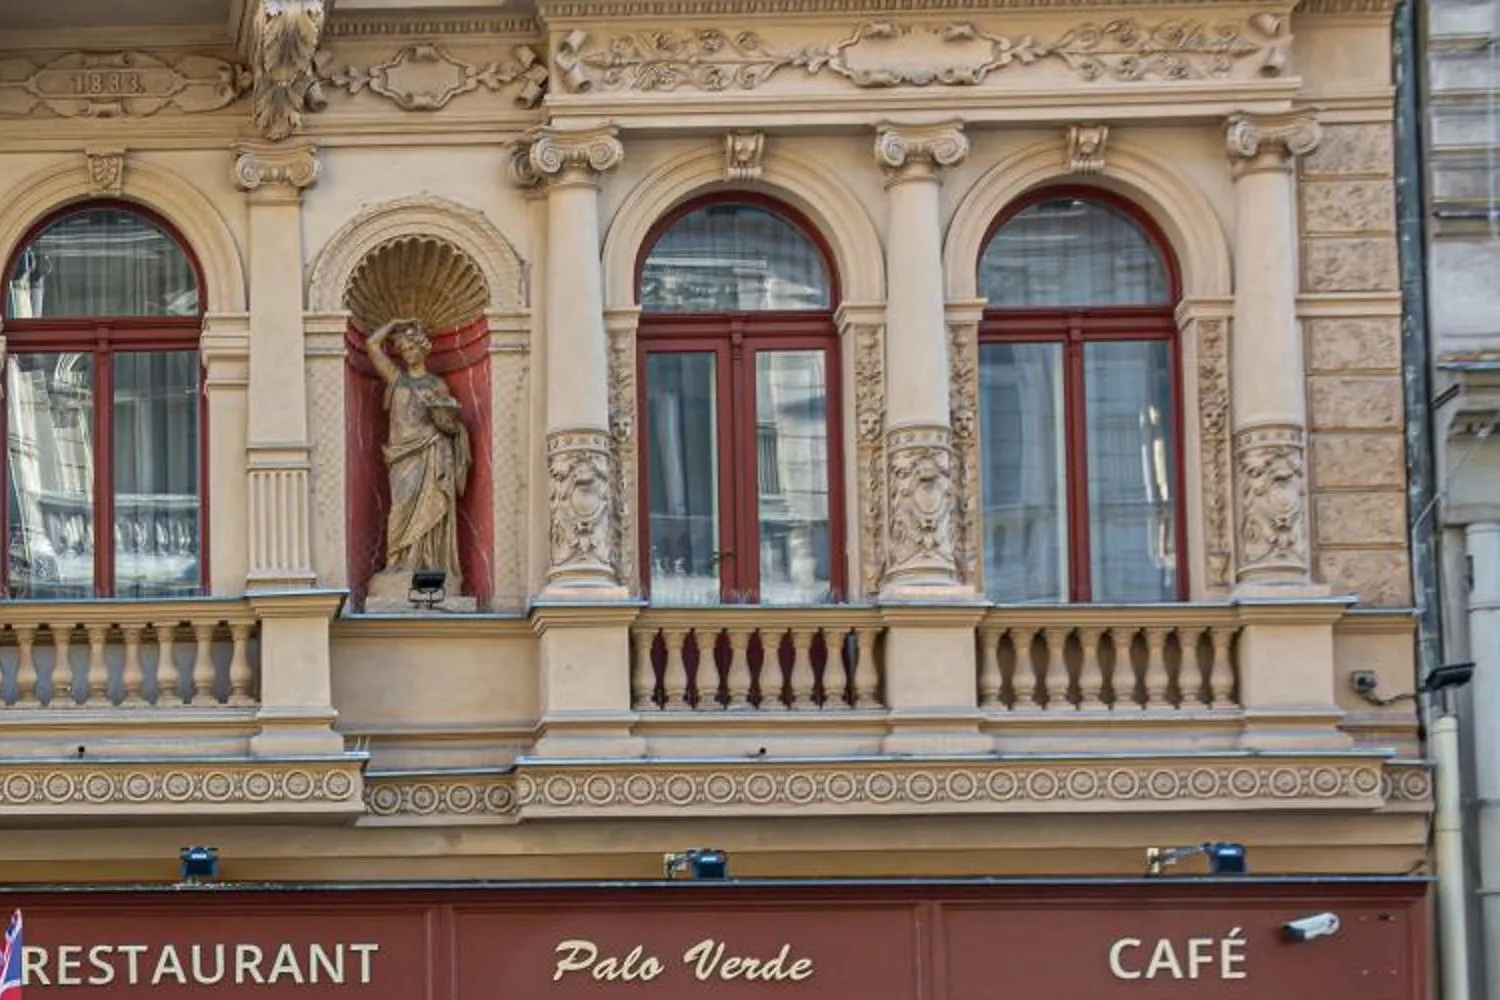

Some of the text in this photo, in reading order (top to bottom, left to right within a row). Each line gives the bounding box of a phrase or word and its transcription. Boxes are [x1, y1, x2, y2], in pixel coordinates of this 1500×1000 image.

[20, 942, 380, 986] RESTAURANT
[553, 938, 814, 982] Palo Verde
[1108, 927, 1248, 980] CAFÉ
